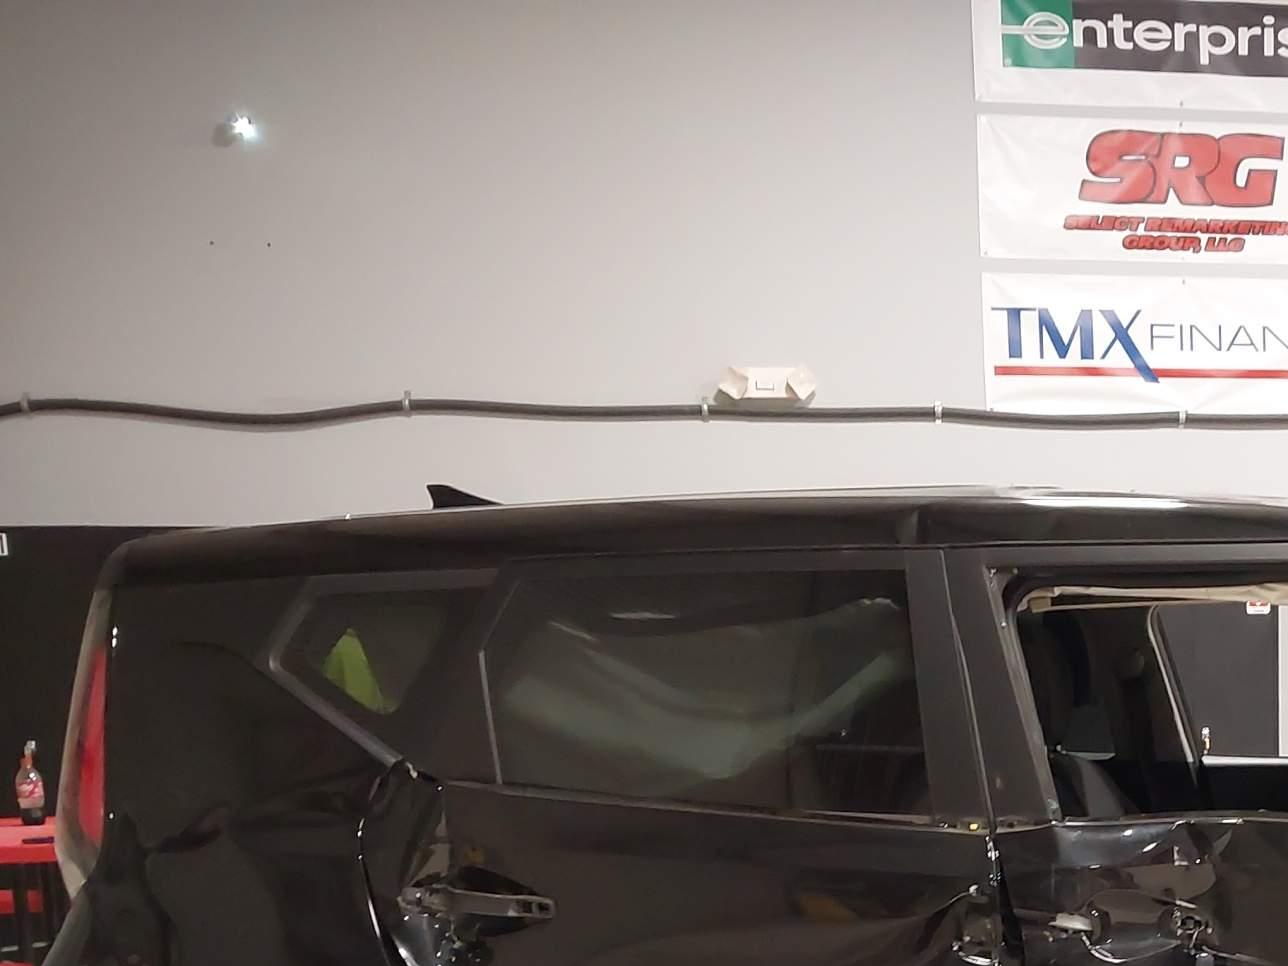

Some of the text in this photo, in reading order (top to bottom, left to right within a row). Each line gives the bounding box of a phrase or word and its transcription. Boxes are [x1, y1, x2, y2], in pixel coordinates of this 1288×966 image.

[1078, 129, 1286, 208] SRG
[1064, 215, 1144, 232] SELECT
[1123, 235, 1245, 253] GROUP, LLC
[991, 307, 1160, 384] TMX
